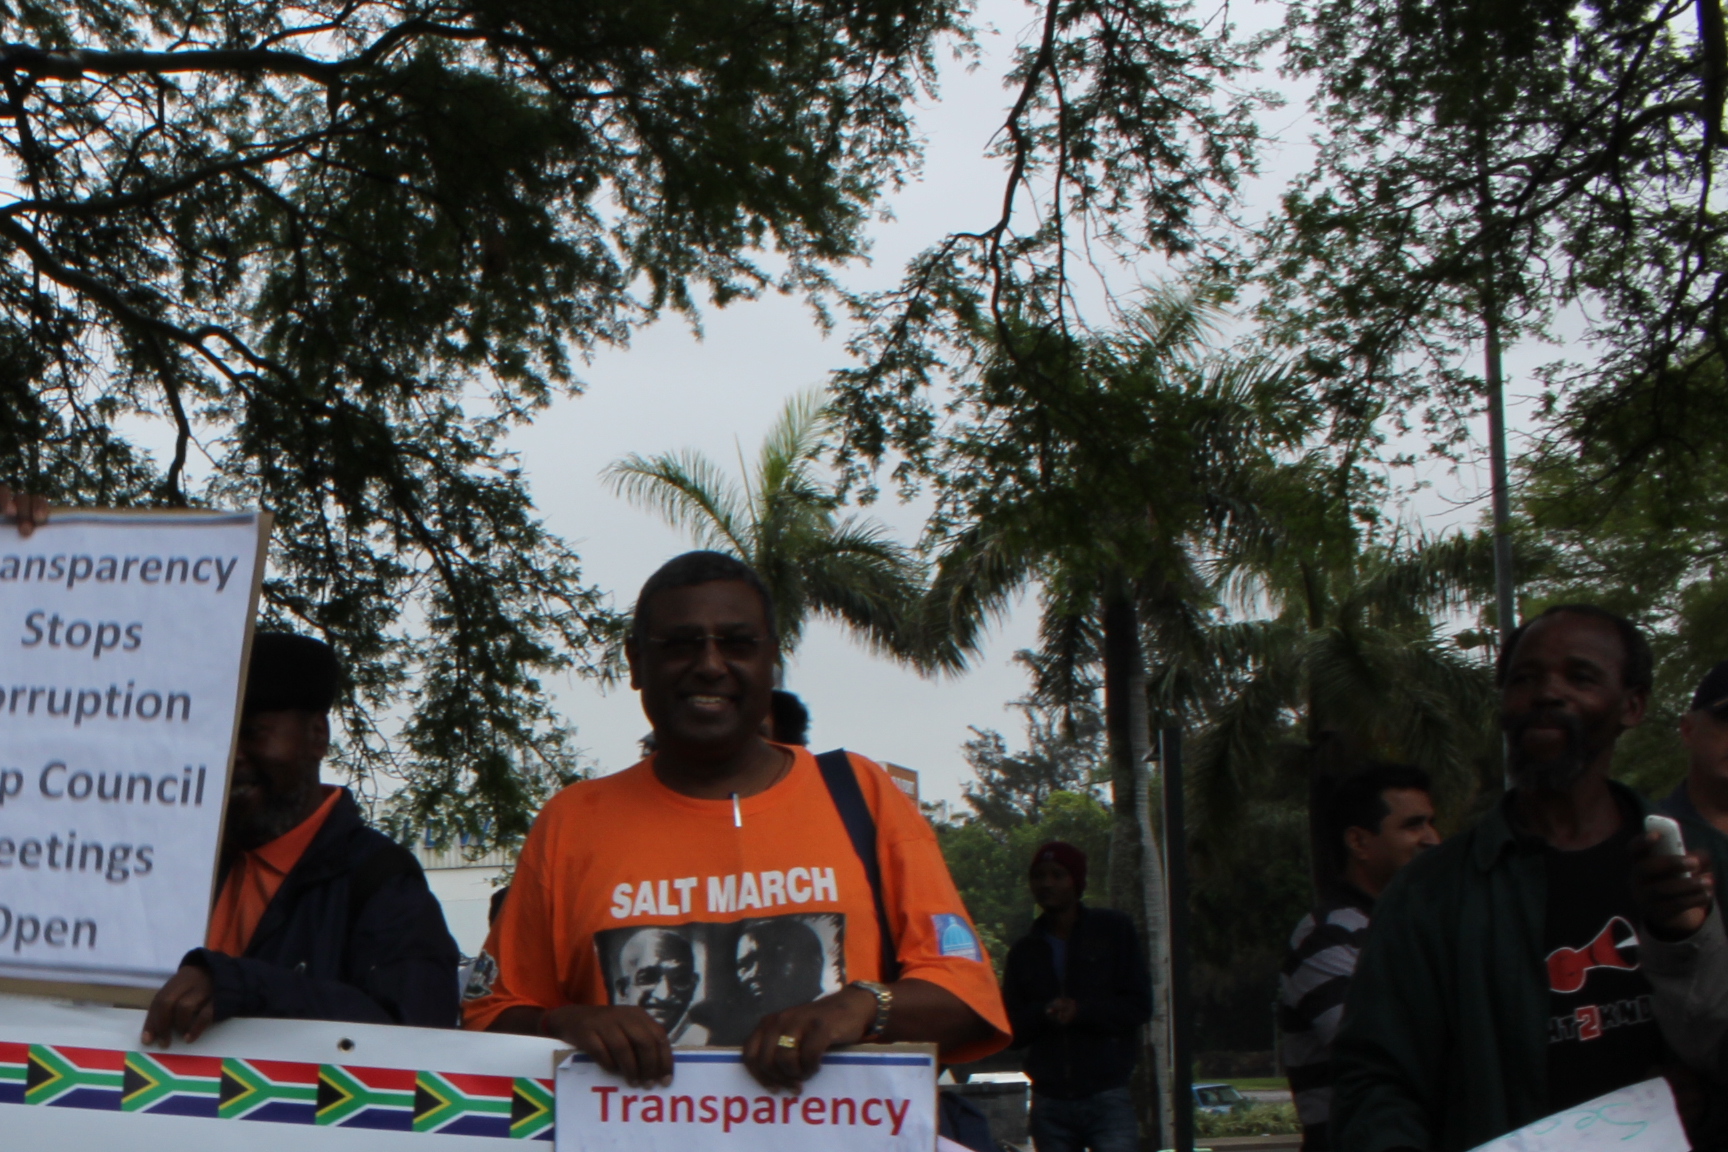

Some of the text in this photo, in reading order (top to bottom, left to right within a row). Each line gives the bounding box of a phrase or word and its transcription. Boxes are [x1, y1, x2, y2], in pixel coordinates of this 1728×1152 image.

[21, 610, 143, 659] Stops
[38, 761, 207, 806] Council
[610, 866, 839, 919] SALT MARCH
[590, 1085, 911, 1137] Transparency
